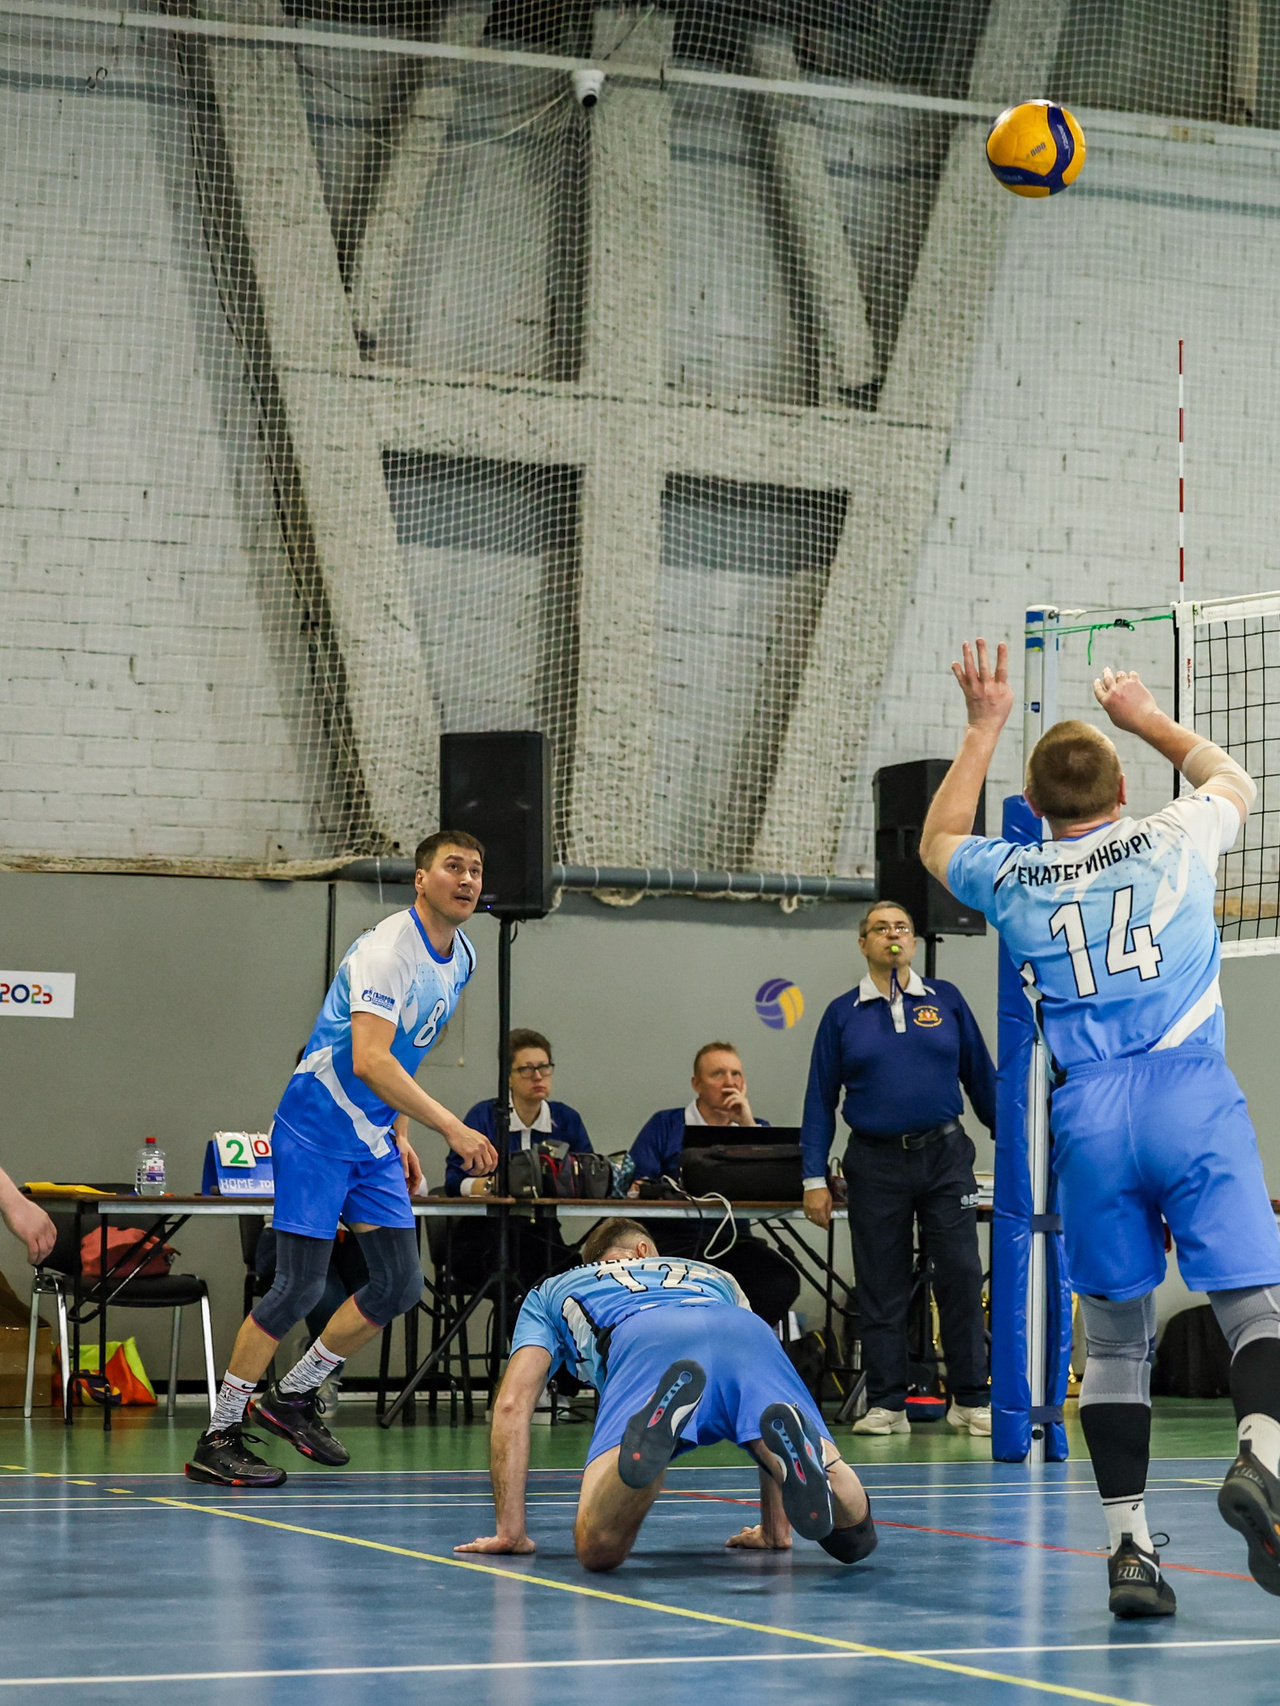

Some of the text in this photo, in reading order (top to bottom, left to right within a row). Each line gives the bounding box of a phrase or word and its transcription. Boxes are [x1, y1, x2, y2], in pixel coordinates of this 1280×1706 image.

[1049, 884, 1164, 999] 14
[412, 997, 446, 1048] 8
[226, 1139, 270, 1165] 2 0
[220, 1178, 254, 1189] HOME
[593, 1263, 704, 1293] 12
